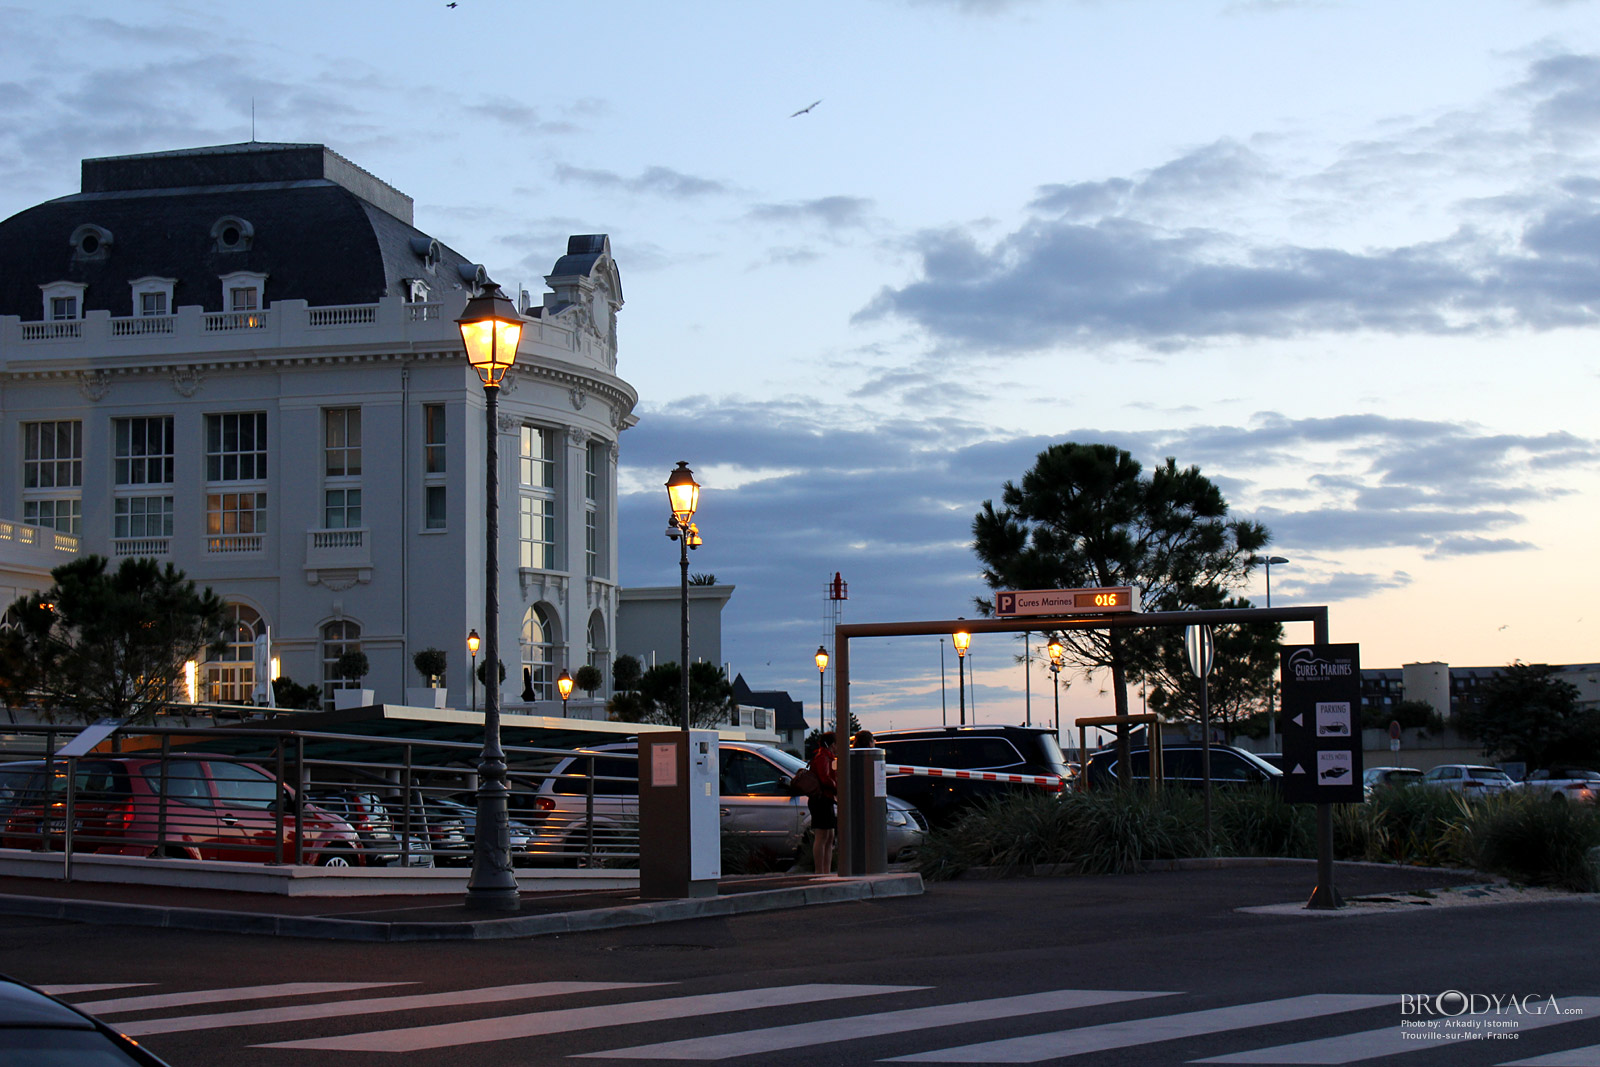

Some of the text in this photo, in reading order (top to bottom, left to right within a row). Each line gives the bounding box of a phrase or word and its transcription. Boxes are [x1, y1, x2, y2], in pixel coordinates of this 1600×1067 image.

[1001, 596, 1073, 611] P Cures Marines
[1094, 593, 1117, 606] 016
[1295, 663, 1352, 676] CURES MARINES
[1320, 704, 1347, 714] PARKING
